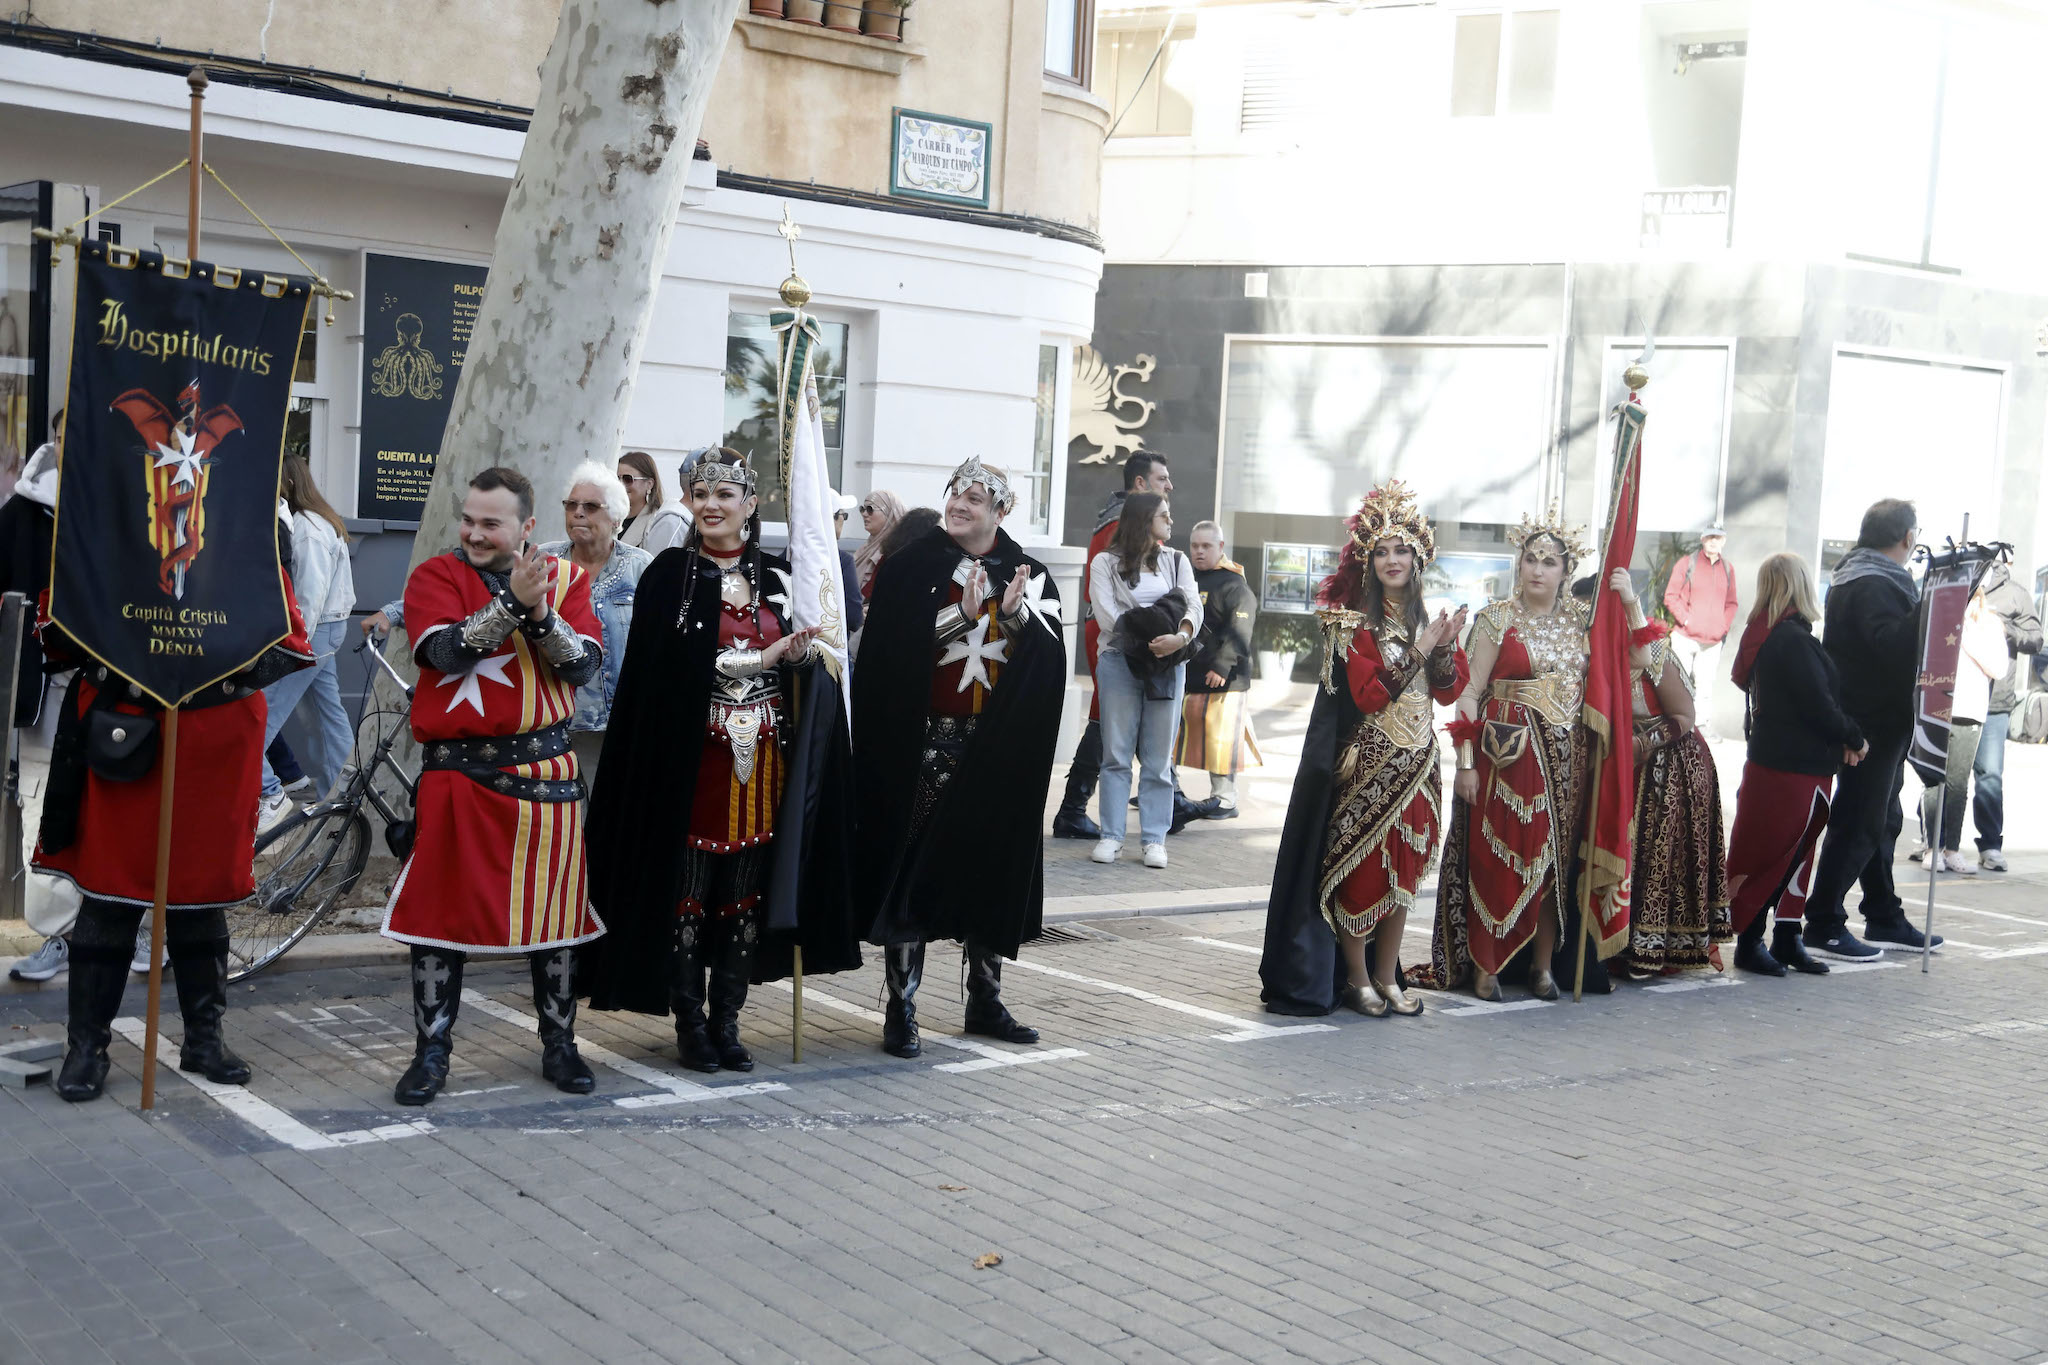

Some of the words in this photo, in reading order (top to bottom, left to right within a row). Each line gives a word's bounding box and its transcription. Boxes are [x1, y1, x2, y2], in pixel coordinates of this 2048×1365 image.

[918, 138, 952, 153] CARRER
[955, 147, 966, 156] DEL
[942, 158, 950, 170] DE
[951, 159, 972, 173] CAMPO
[1664, 192, 1727, 212] ALQUILA
[97, 298, 274, 376] Hospitalaris
[377, 450, 417, 463] CUENTA
[419, 453, 433, 464] LA
[377, 467, 387, 475] En
[396, 469, 412, 477] siglo
[376, 484, 400, 492] tabaco
[376, 492, 397, 501] largas
[122, 603, 174, 623] Capità
[180, 608, 228, 626] Cristià
[151, 625, 204, 639] MMXXV
